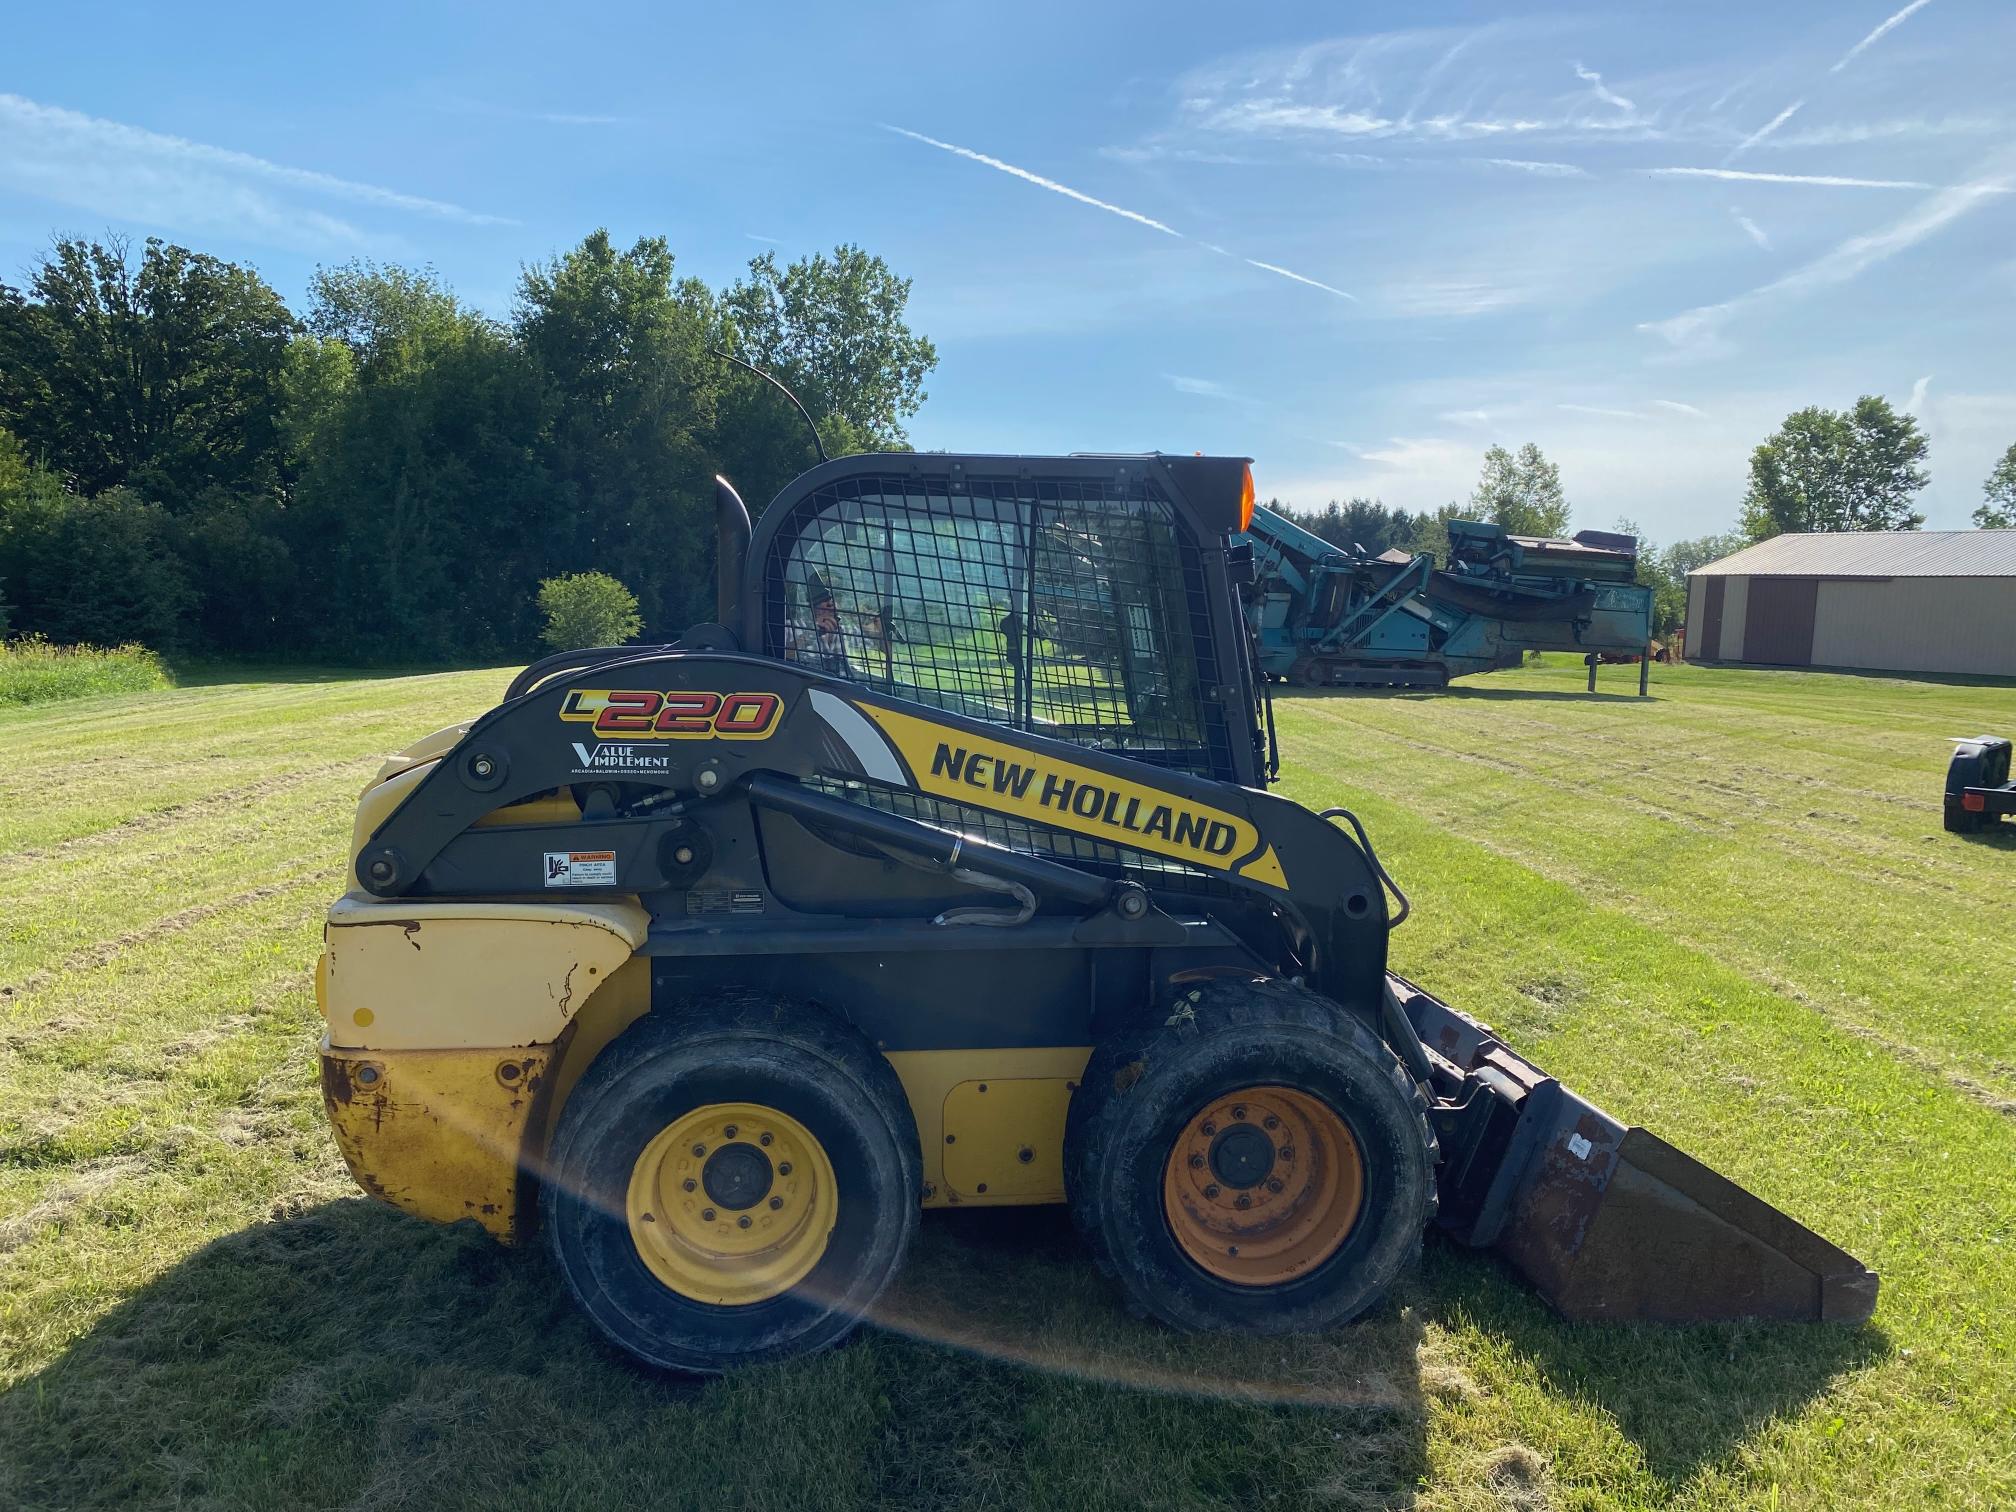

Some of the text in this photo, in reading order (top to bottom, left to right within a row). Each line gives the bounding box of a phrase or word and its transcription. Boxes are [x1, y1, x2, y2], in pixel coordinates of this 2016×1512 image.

[559, 689, 785, 740] L220
[571, 743, 634, 767] VALUE
[594, 757, 670, 767] IMPLEMENT
[929, 741, 1238, 857] NEW HOLLAND
